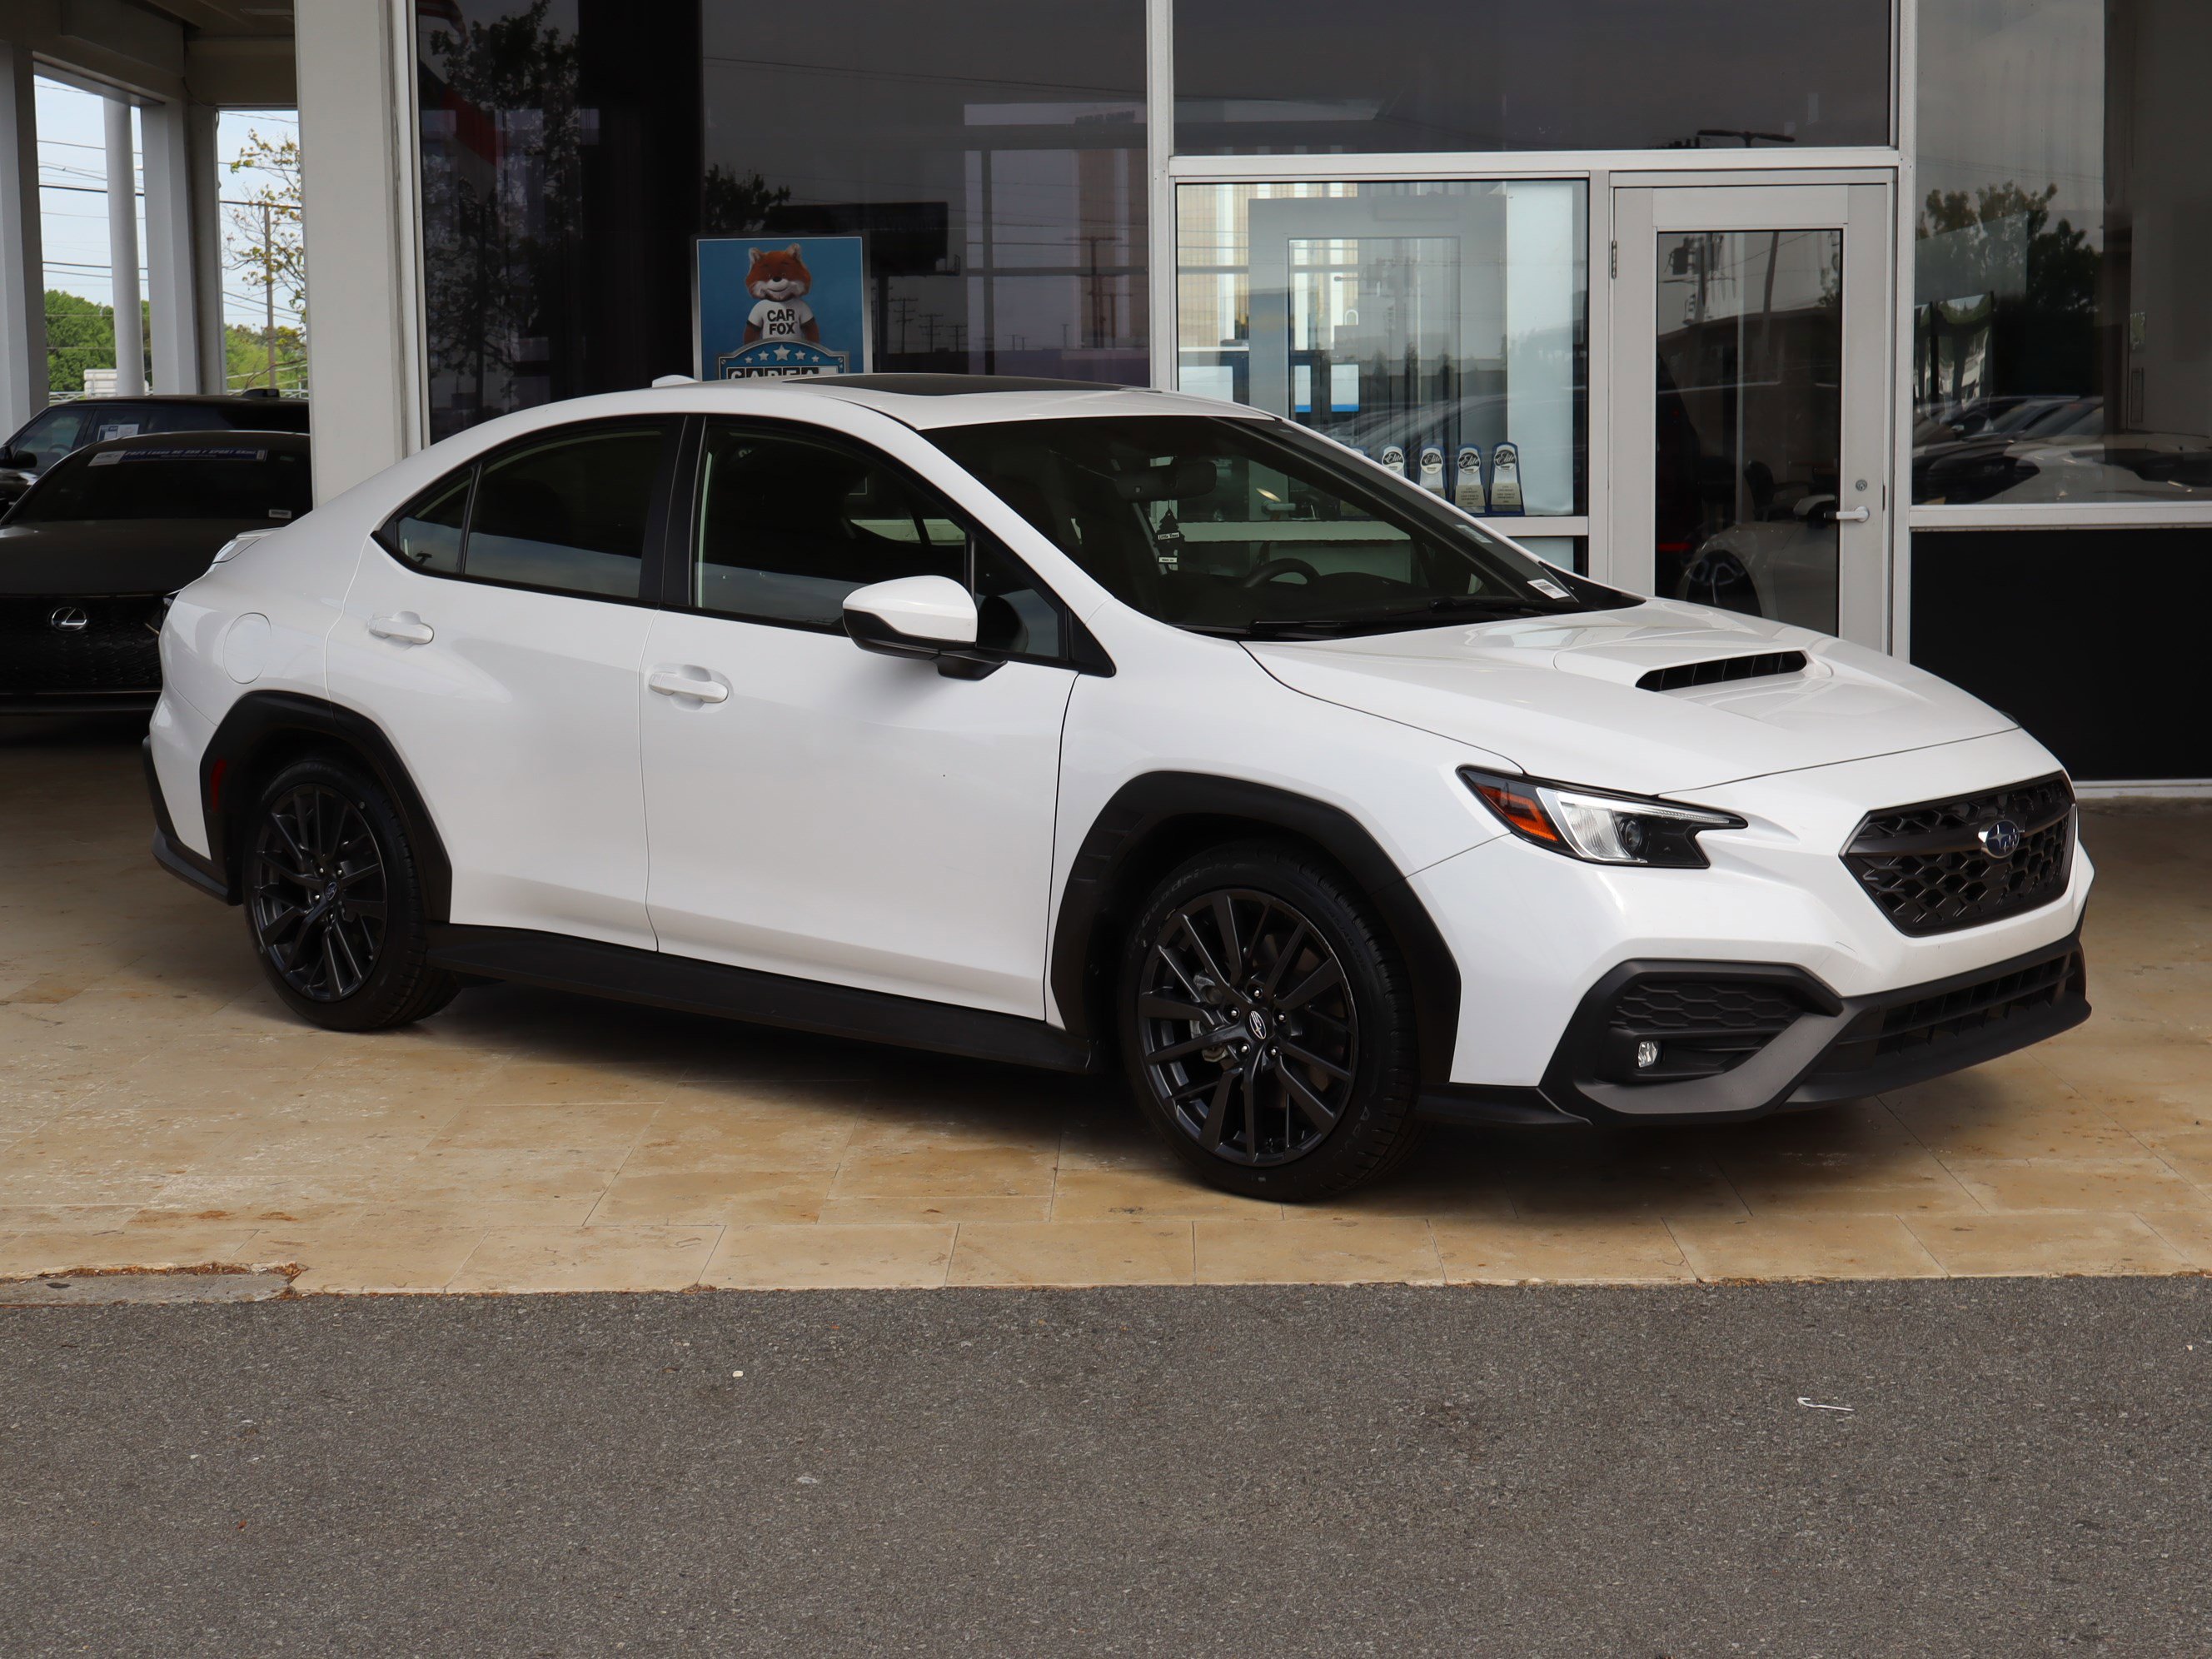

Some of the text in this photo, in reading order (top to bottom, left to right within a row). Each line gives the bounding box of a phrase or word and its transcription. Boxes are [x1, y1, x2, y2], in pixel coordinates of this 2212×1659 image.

[767, 309, 795, 321] CAR
[770, 323, 795, 335] FOX
[1384, 453, 1402, 464] Elite
[1423, 454, 1441, 465] Elite
[1459, 454, 1480, 467] Elite
[1495, 451, 1515, 465] Elite
